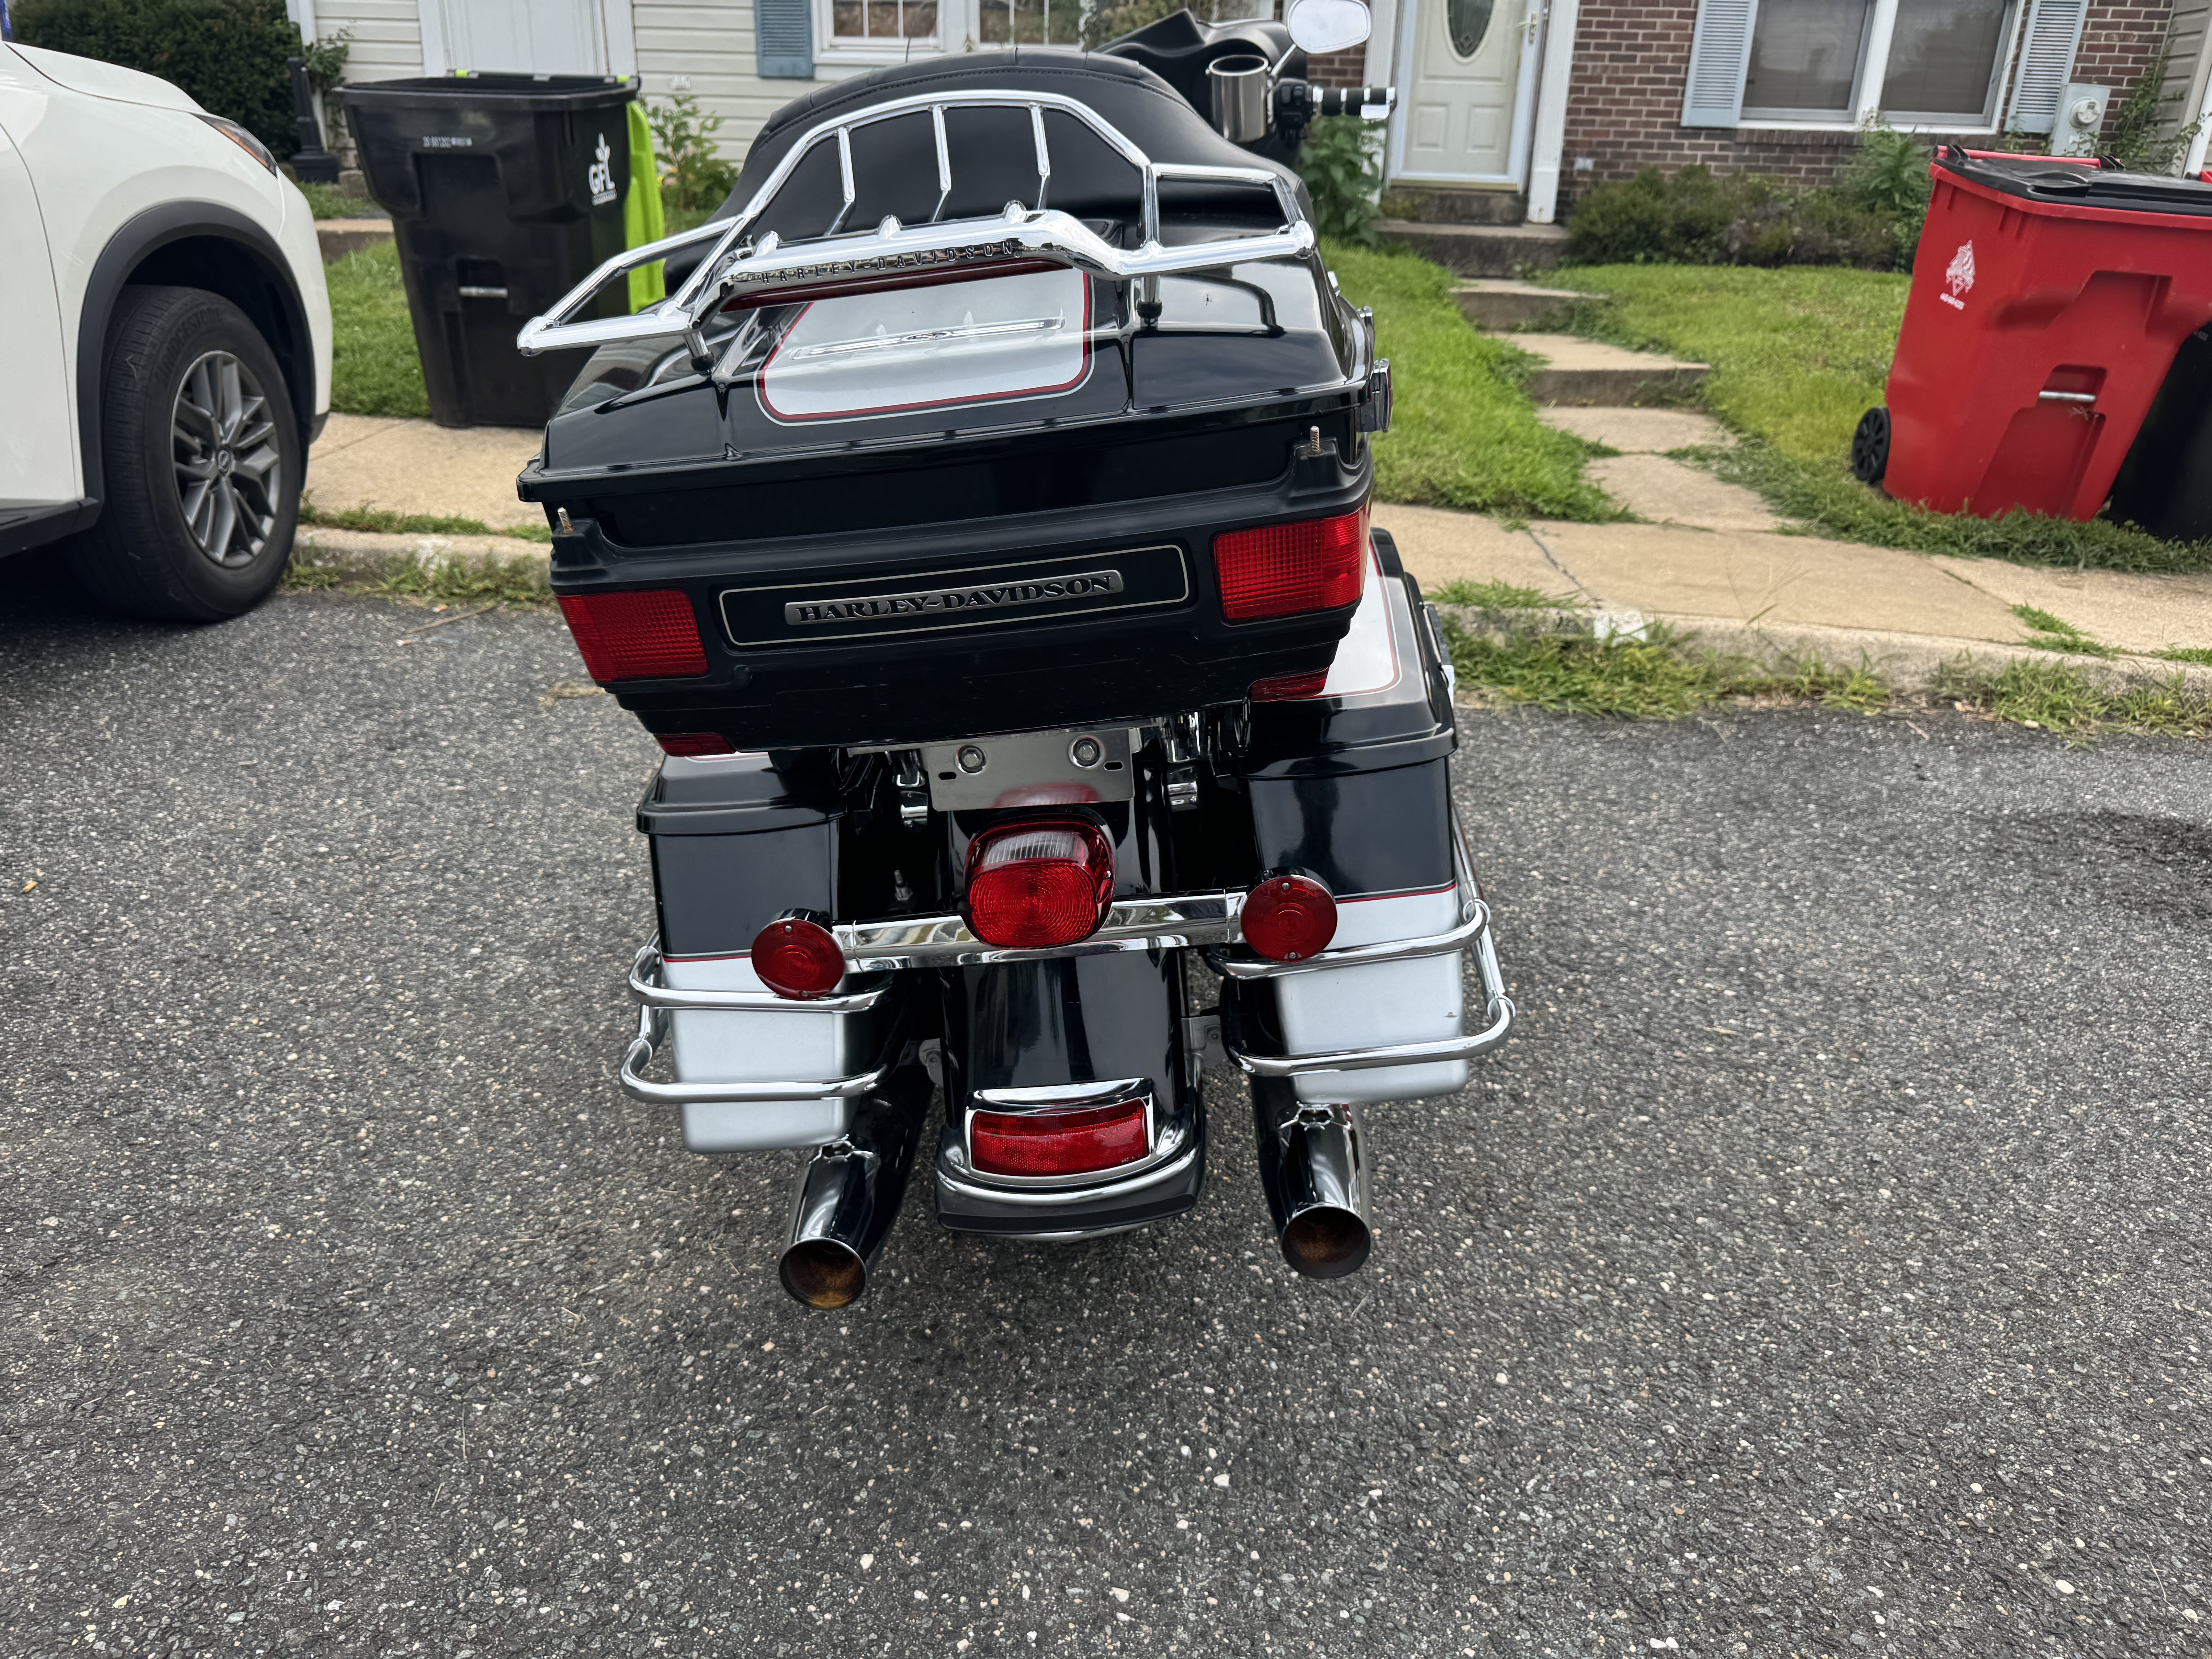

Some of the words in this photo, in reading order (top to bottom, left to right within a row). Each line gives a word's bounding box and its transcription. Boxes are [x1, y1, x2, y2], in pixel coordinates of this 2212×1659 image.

[589, 163, 615, 194] GFL
[762, 240, 1013, 284] HARLEY-DAVIDSON
[795, 575, 1112, 622] HARLEY-DAVIDSON
